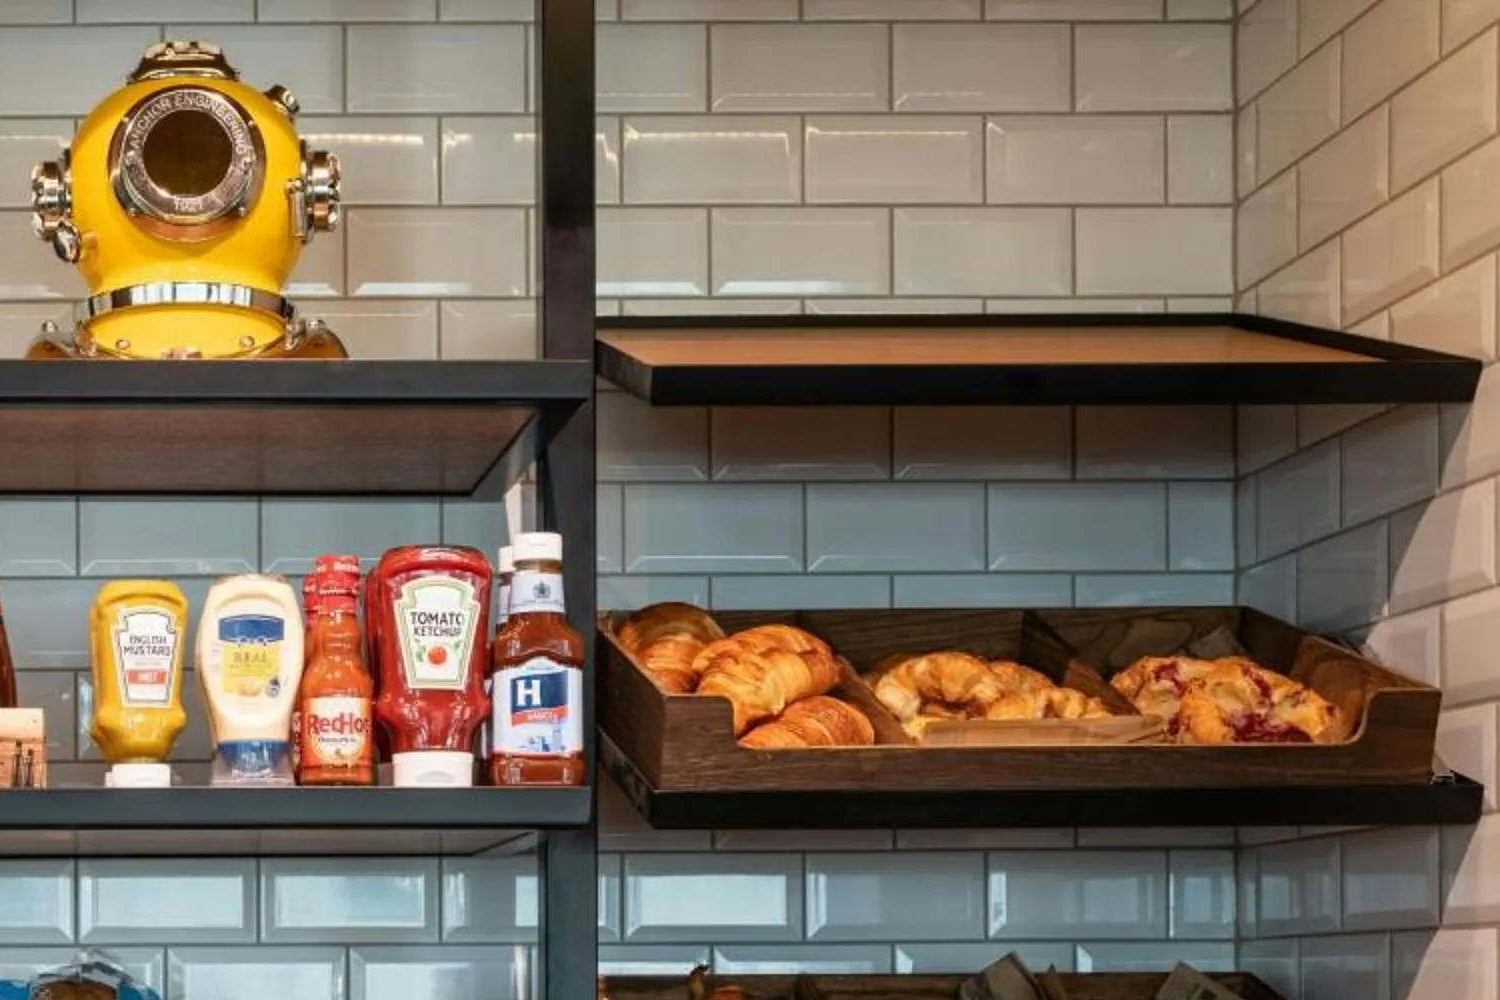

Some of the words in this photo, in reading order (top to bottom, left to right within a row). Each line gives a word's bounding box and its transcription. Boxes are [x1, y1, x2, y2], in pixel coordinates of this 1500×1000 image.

[129, 97, 173, 150] ANCHOR
[174, 93, 248, 155] ENGINEERING
[410, 611, 466, 625] TOMATO
[413, 626, 462, 637] KETCHUP
[129, 635, 168, 645] ENGLISH
[123, 645, 171, 656] MUSTARD
